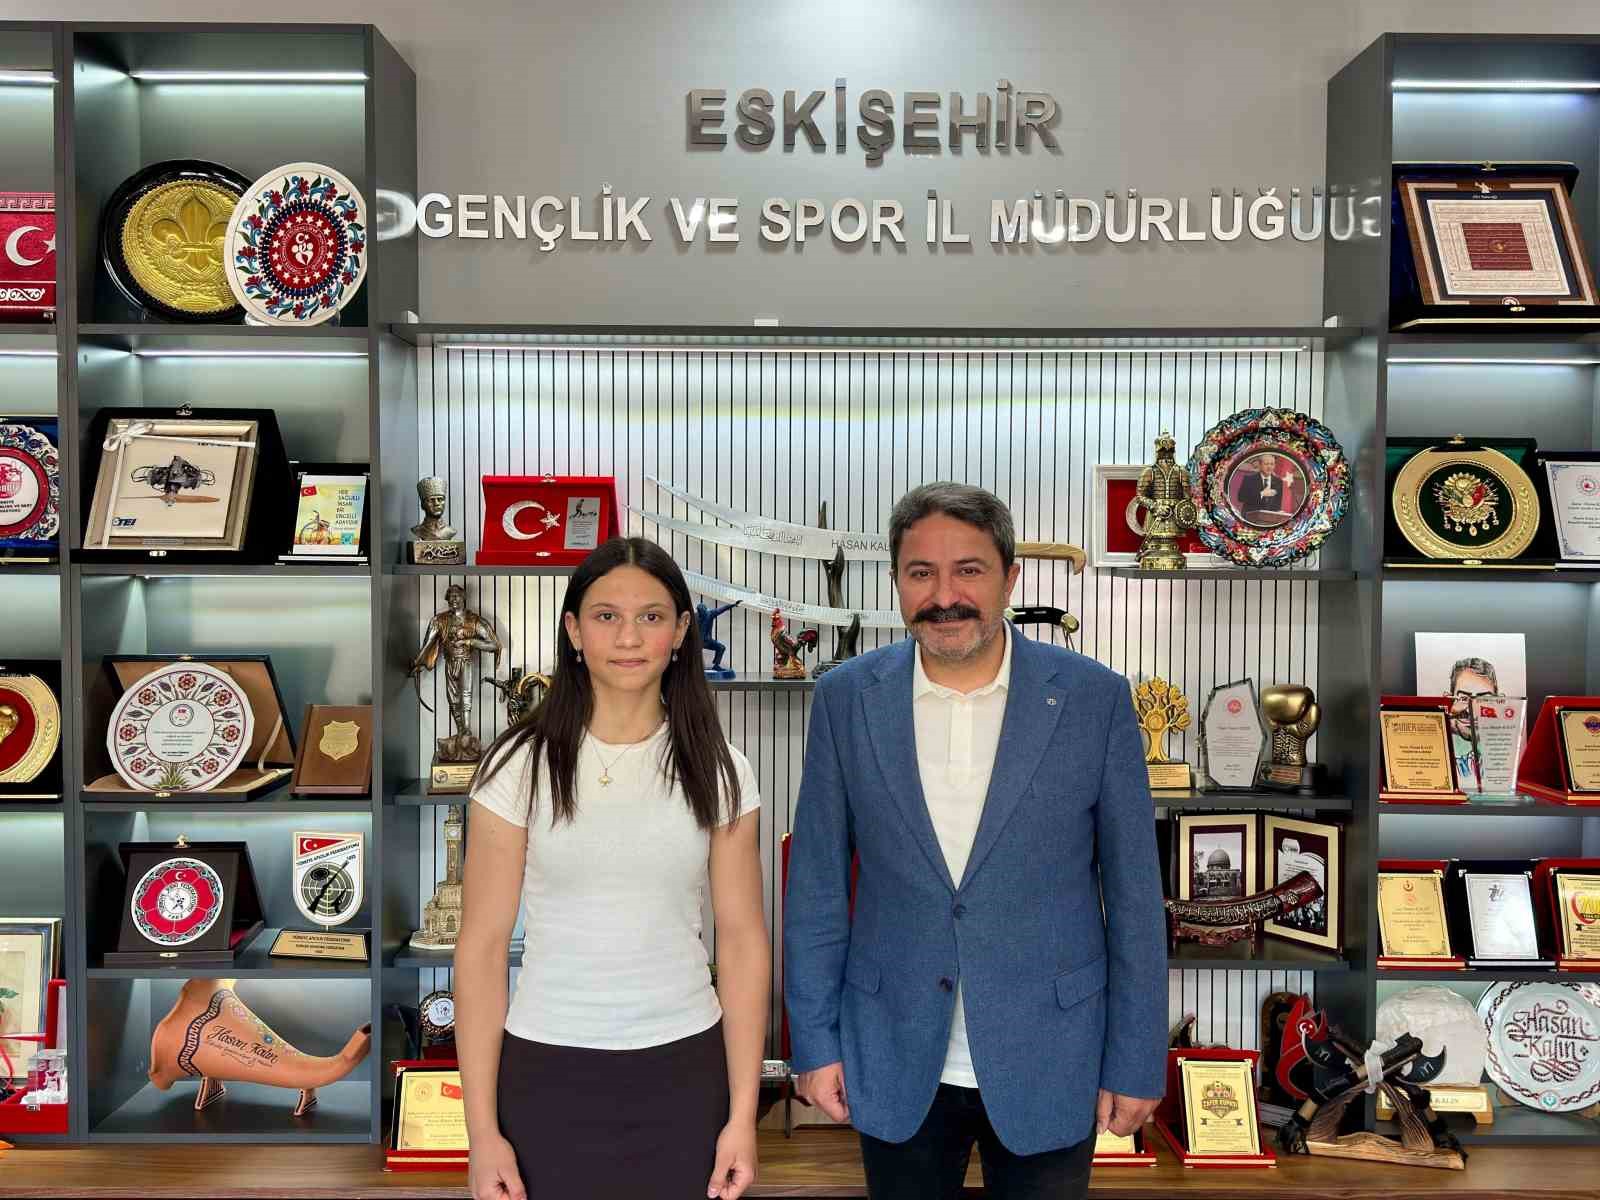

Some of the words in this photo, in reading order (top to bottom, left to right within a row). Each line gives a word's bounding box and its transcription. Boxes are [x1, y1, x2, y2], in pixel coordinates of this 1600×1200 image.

[686, 78, 1062, 167] ESKİŞEHİR
[416, 183, 653, 251] GENÇLİK
[671, 198, 740, 243] VE
[760, 198, 906, 244] SPOR
[926, 189, 970, 244] İL
[990, 185, 1323, 244] MÜDÜRLÜĞÜ
[831, 539, 868, 551] HASAN
[870, 542, 890, 551] KAL
[207, 1025, 248, 1051] Hasan
[1505, 1000, 1592, 1039] Hasan
